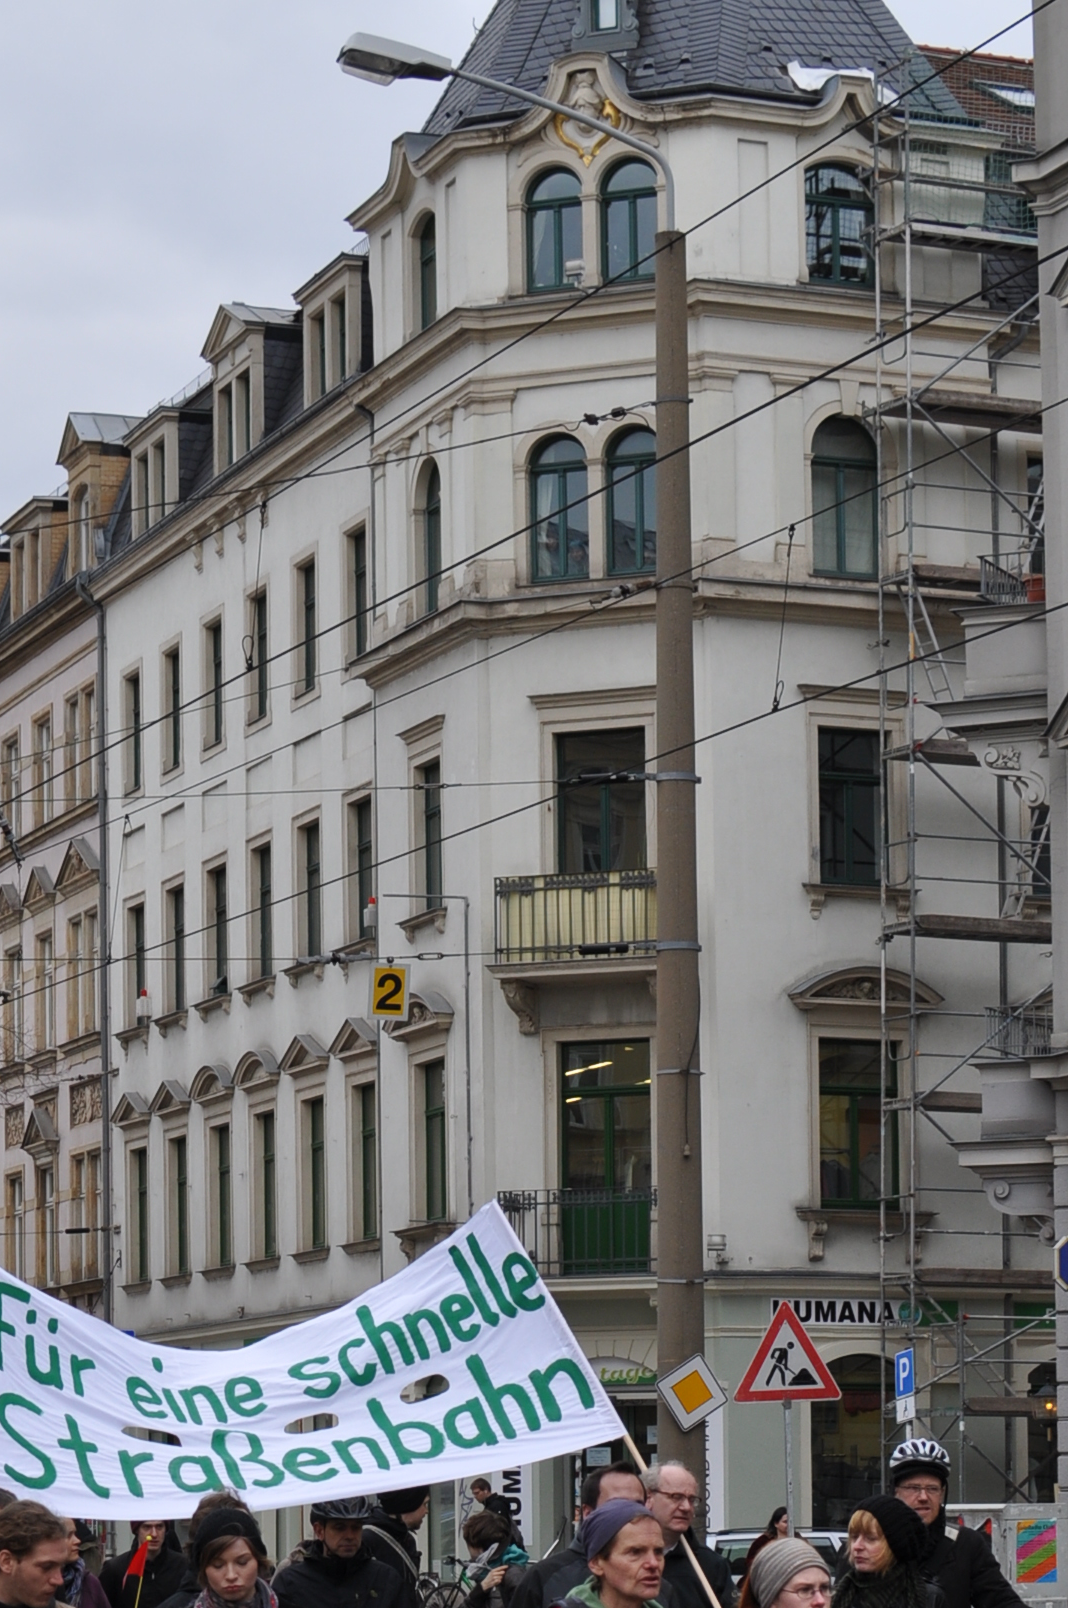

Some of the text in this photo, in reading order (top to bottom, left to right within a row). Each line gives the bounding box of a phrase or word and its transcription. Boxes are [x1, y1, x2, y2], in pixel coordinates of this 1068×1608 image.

[376, 972, 402, 1011] 2
[126, 1357, 267, 1425] eine
[288, 1232, 545, 1399] schnelle
[899, 1357, 910, 1391] P
